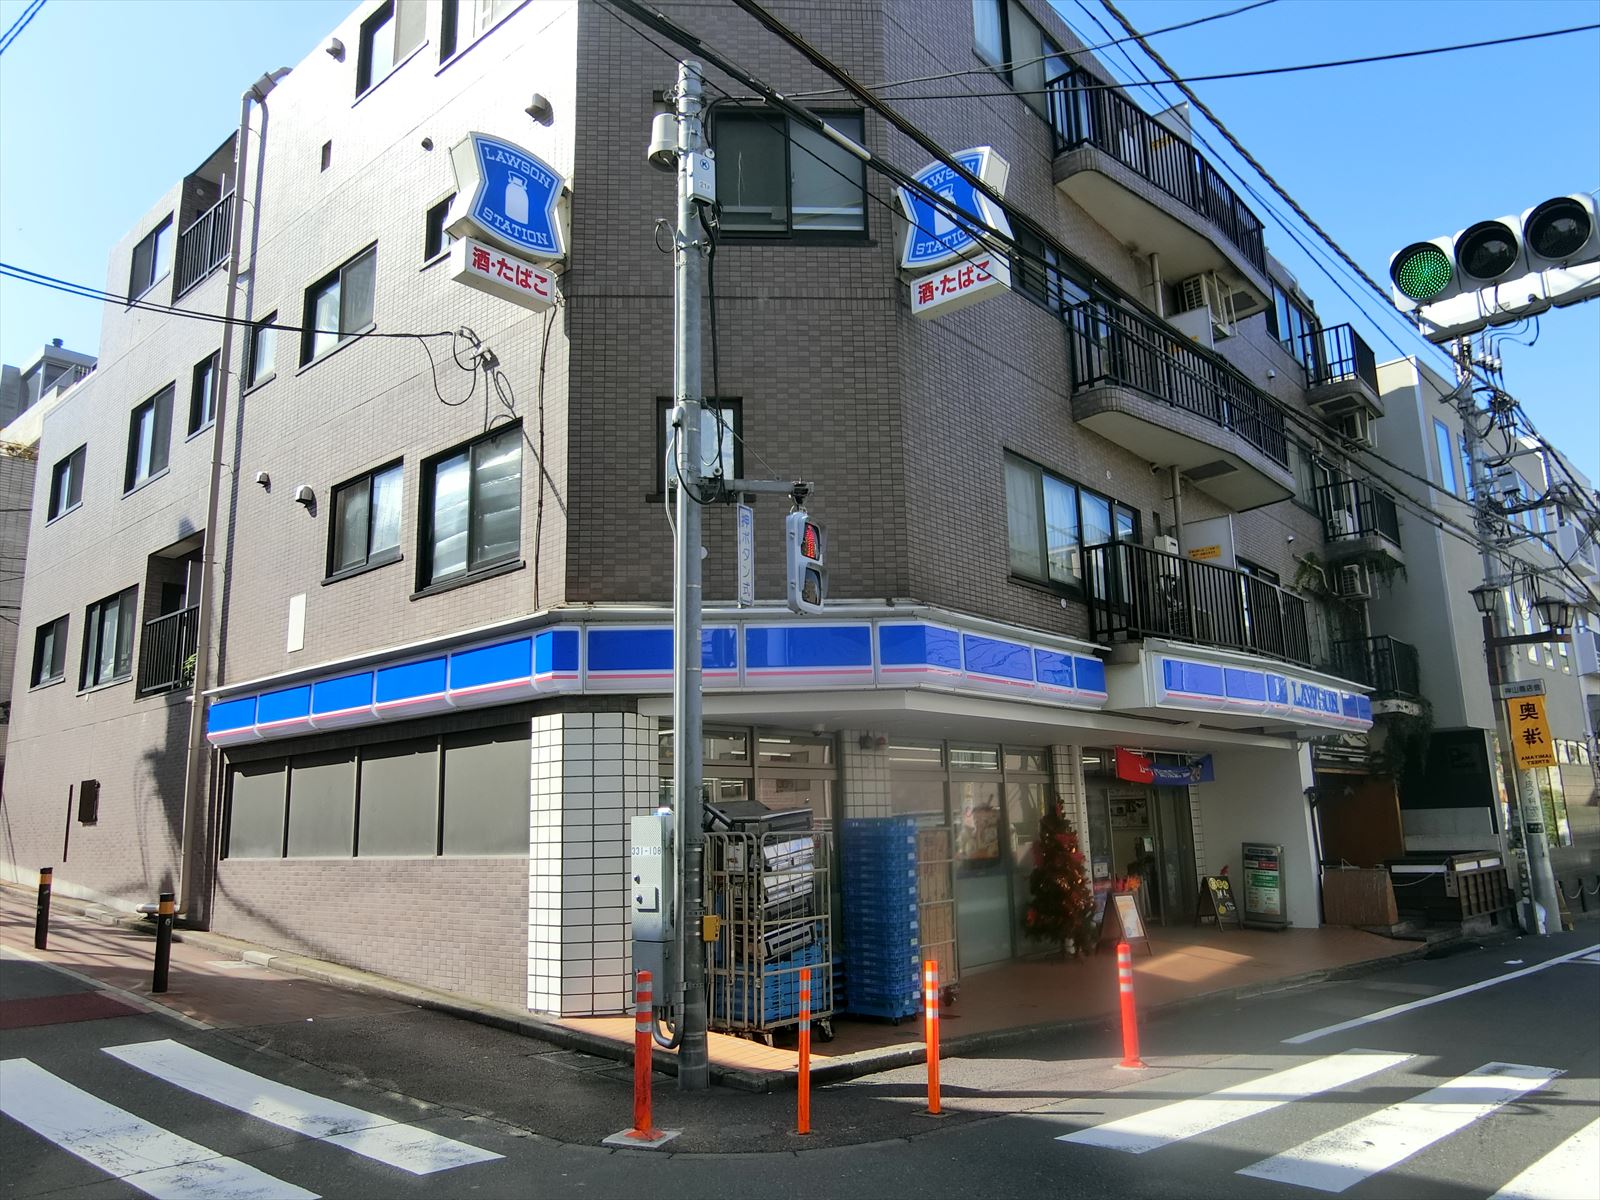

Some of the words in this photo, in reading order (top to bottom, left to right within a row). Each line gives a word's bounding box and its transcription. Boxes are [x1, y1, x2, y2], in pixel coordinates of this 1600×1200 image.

[484, 146, 551, 189] LAWSON
[914, 160, 976, 198] AWSN
[483, 207, 549, 245] STATION
[472, 246, 548, 296] 酒・たばこ
[918, 260, 992, 304] 酒・たばこ
[1291, 680, 1340, 714] LAWSON
